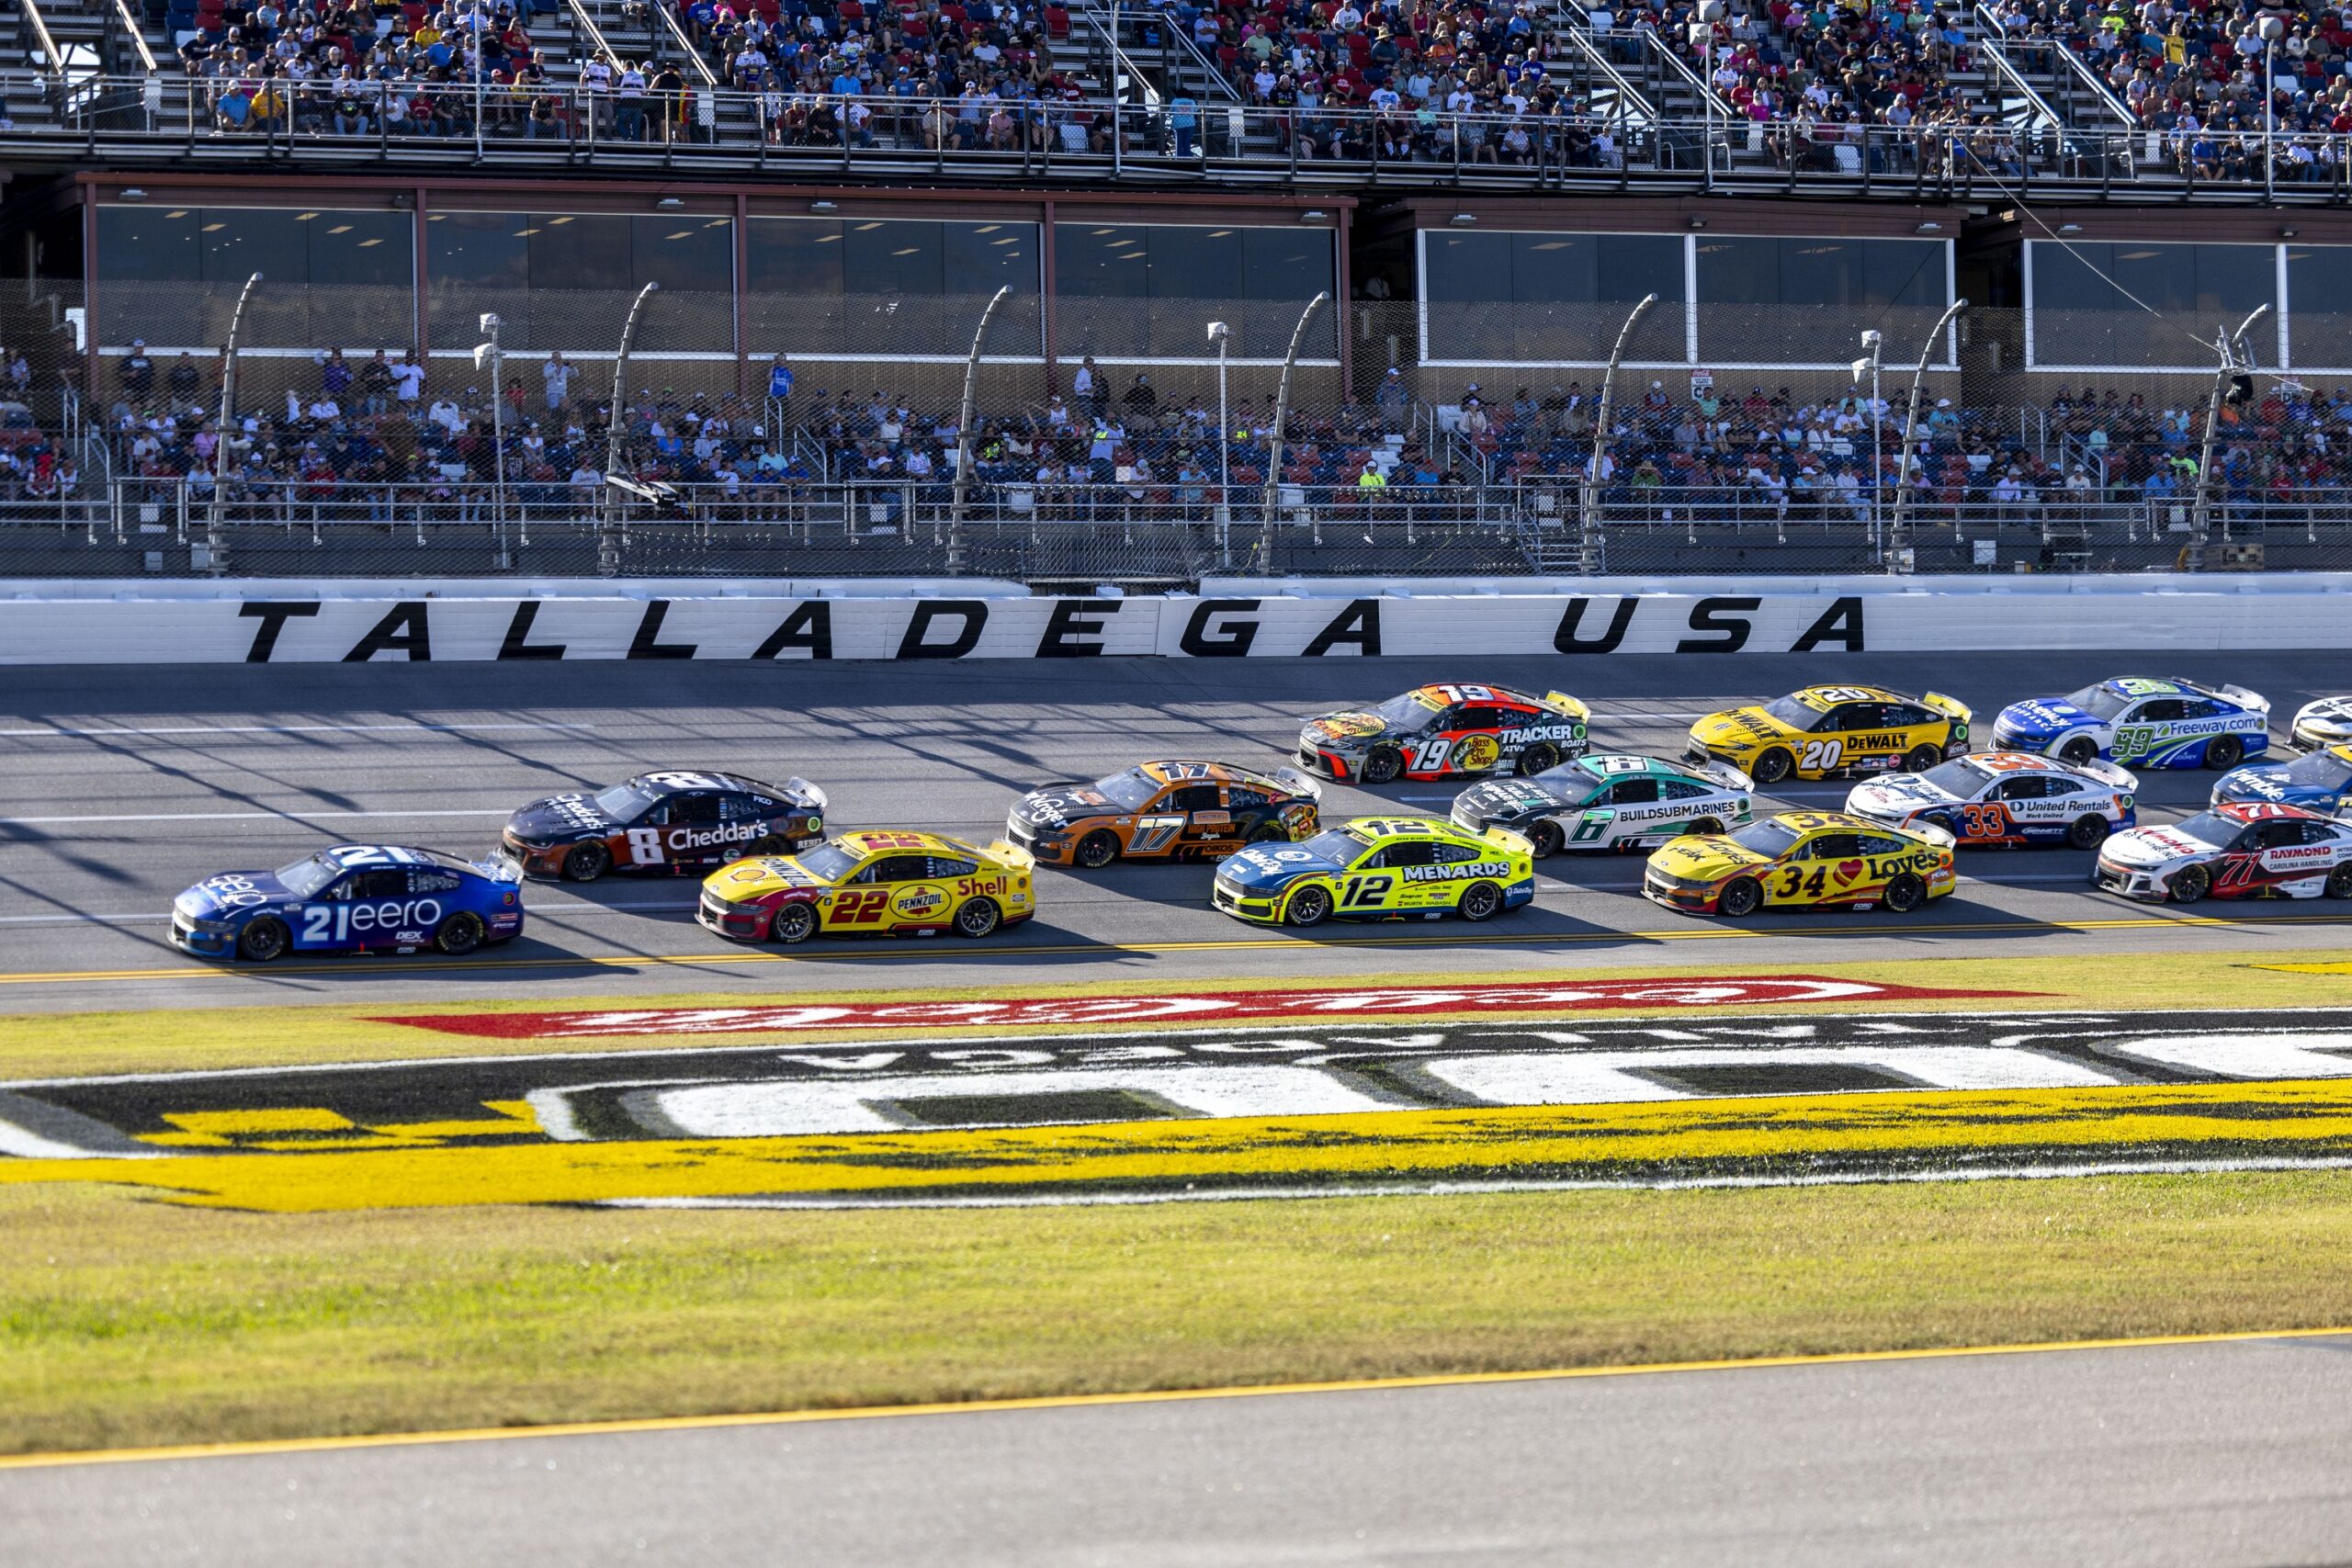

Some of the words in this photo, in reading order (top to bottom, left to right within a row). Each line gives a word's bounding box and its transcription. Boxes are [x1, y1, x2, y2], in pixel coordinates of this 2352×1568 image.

[239, 599, 1381, 663] TALLADEGA
[1555, 598, 1863, 654] USA
[1438, 685, 1494, 702] 19
[1812, 688, 1876, 702] 20
[1500, 725, 1571, 743] TRACKER
[2170, 717, 2256, 734] Freeway.com
[1472, 738, 1489, 747] Bass
[1561, 739, 1586, 748] BOATS
[2109, 725, 2155, 757] 99
[1410, 739, 1451, 771] 19
[1470, 755, 1493, 766] Shops
[1472, 747, 1485, 755] Pro
[1800, 739, 1843, 770] 20
[1158, 762, 1211, 781] 17
[2227, 769, 2285, 801] Trimble
[753, 795, 773, 806] FICO
[1024, 792, 1069, 828] Kroger
[2027, 800, 2065, 811] United
[2068, 799, 2110, 811] Rentals
[1620, 802, 1735, 821] BUILDSUBMARINES
[1963, 804, 2005, 837] 33
[2235, 804, 2285, 818] 71
[1188, 824, 1206, 834] HIGH
[1207, 823, 1236, 833] PROTEIN
[1367, 820, 1430, 836] 12
[1568, 808, 1617, 844] 6
[1789, 814, 1860, 829] 34
[668, 819, 768, 850] Cheddar's
[861, 833, 926, 851] 22
[1125, 815, 1187, 852] 17
[628, 829, 666, 864] 8
[2270, 846, 2331, 859] RAYMOND
[329, 846, 416, 867] 21
[2269, 862, 2299, 870] CAROLINA
[1402, 862, 1510, 883] MENARDS
[2219, 852, 2263, 886] 71
[957, 875, 1007, 897] Shell
[1776, 865, 1827, 898] 34
[1340, 875, 1393, 908] 12
[828, 891, 888, 924] 22
[898, 894, 943, 910] PENNZOIL
[302, 906, 349, 941] 21
[351, 899, 441, 931] eero
[395, 931, 424, 940] DEX
